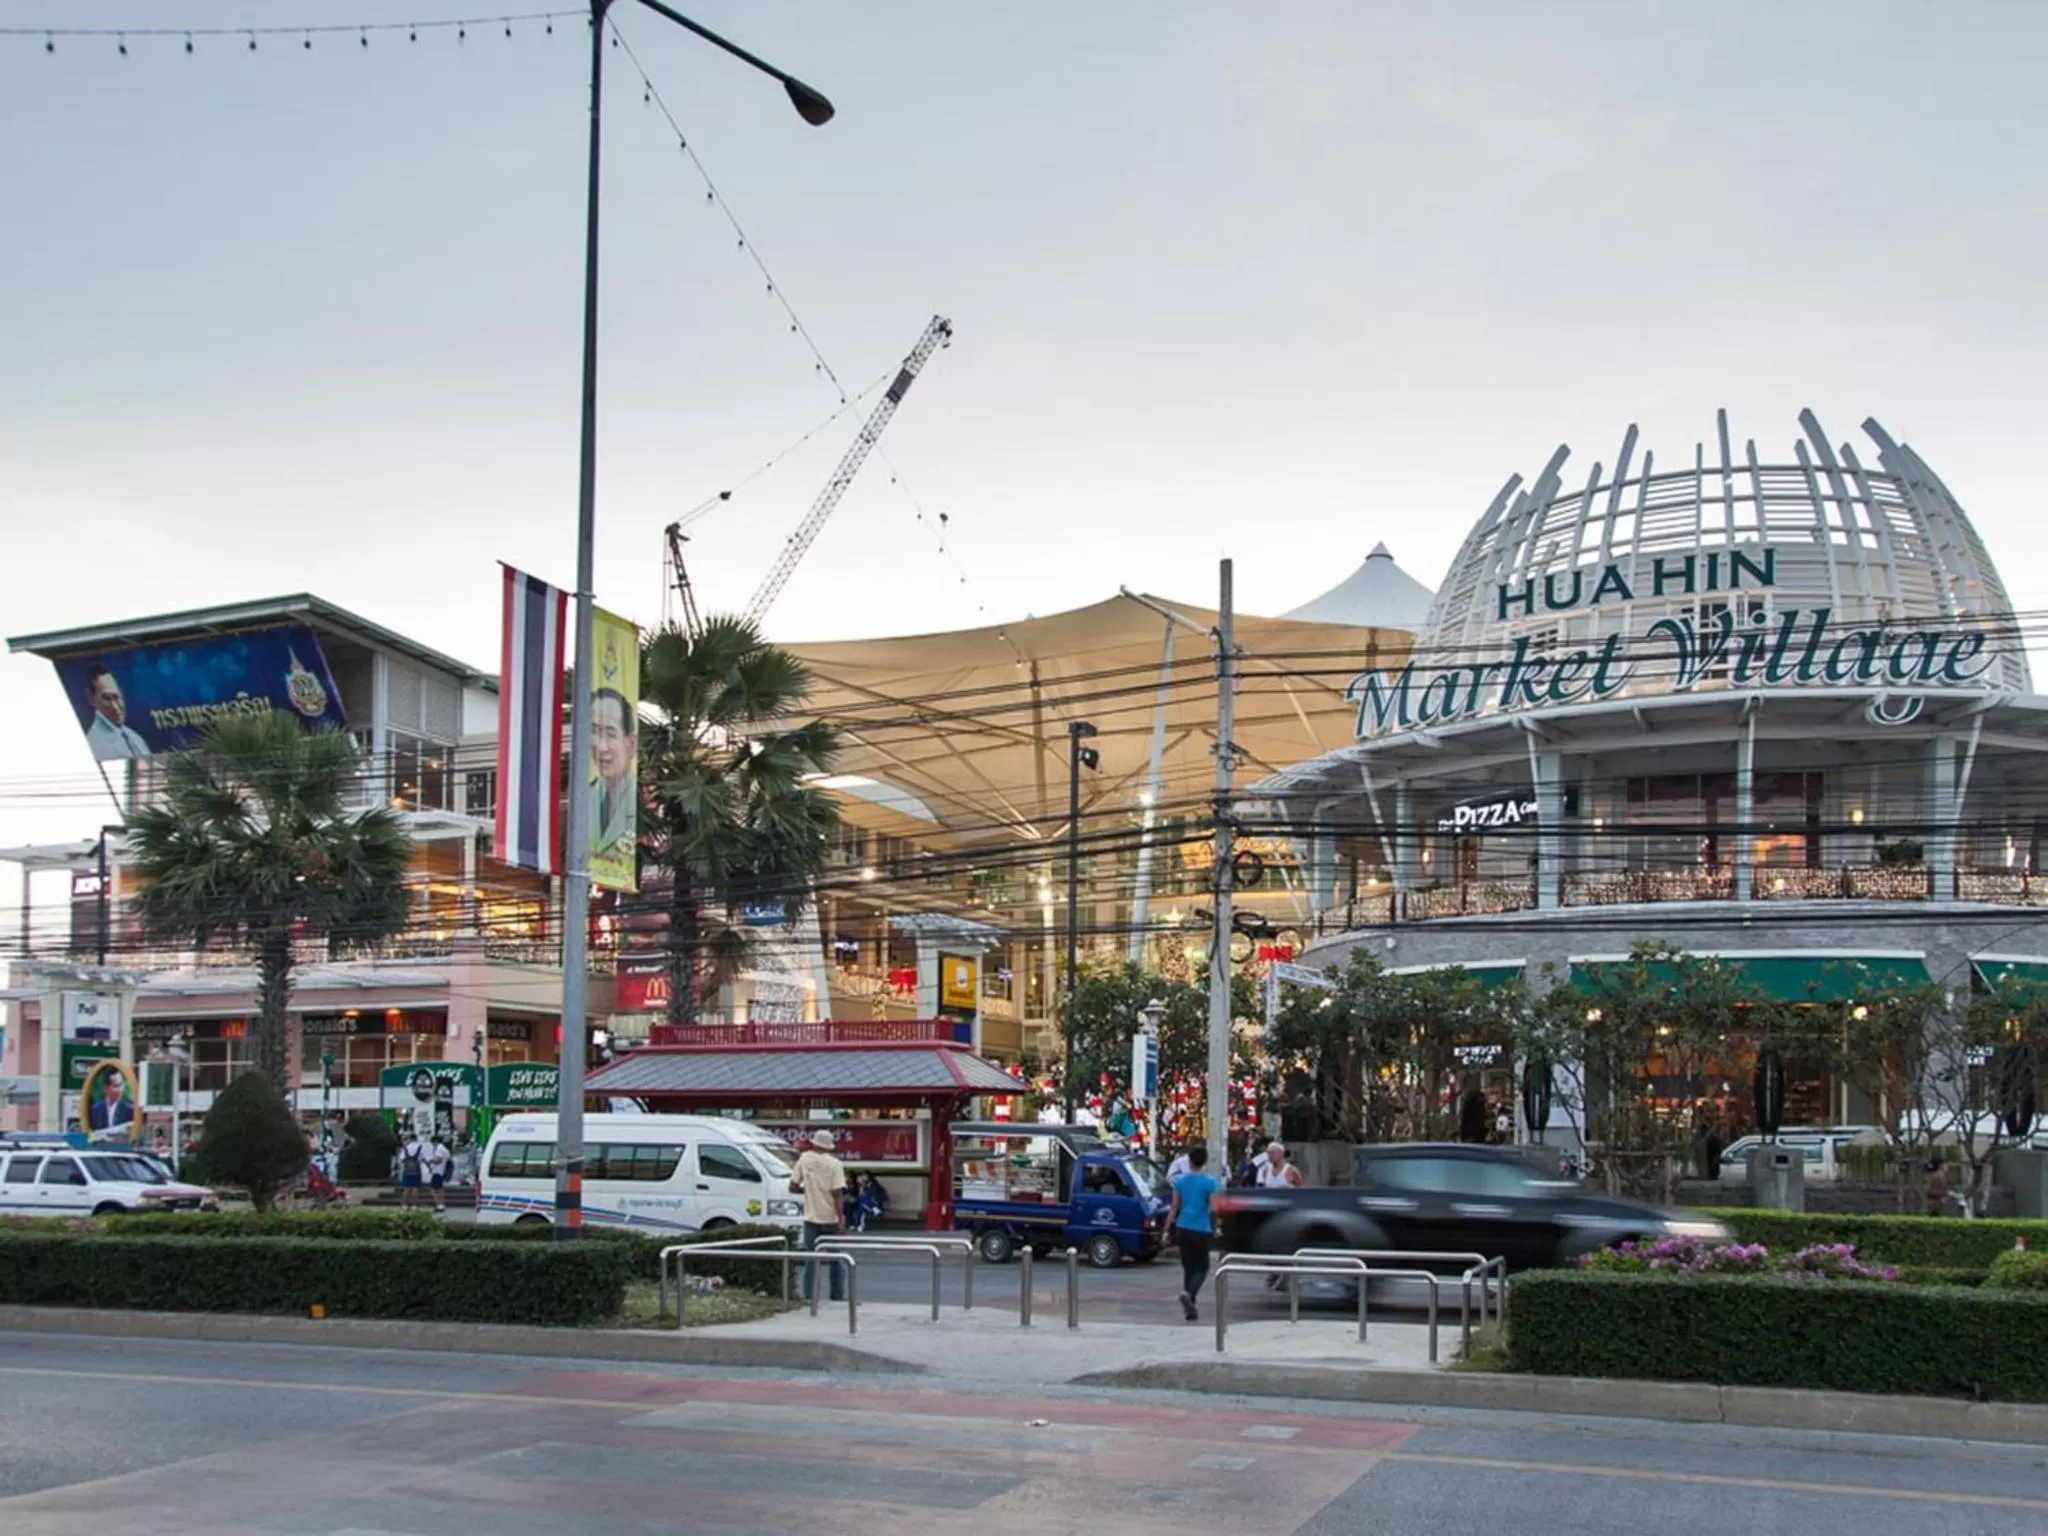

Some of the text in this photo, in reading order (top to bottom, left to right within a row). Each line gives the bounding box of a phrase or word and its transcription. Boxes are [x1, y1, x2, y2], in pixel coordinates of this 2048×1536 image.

[1496, 548, 1776, 621] HUA HIN
[1345, 605, 2002, 740] Market Village
[1454, 800, 1521, 826] PIZZA
